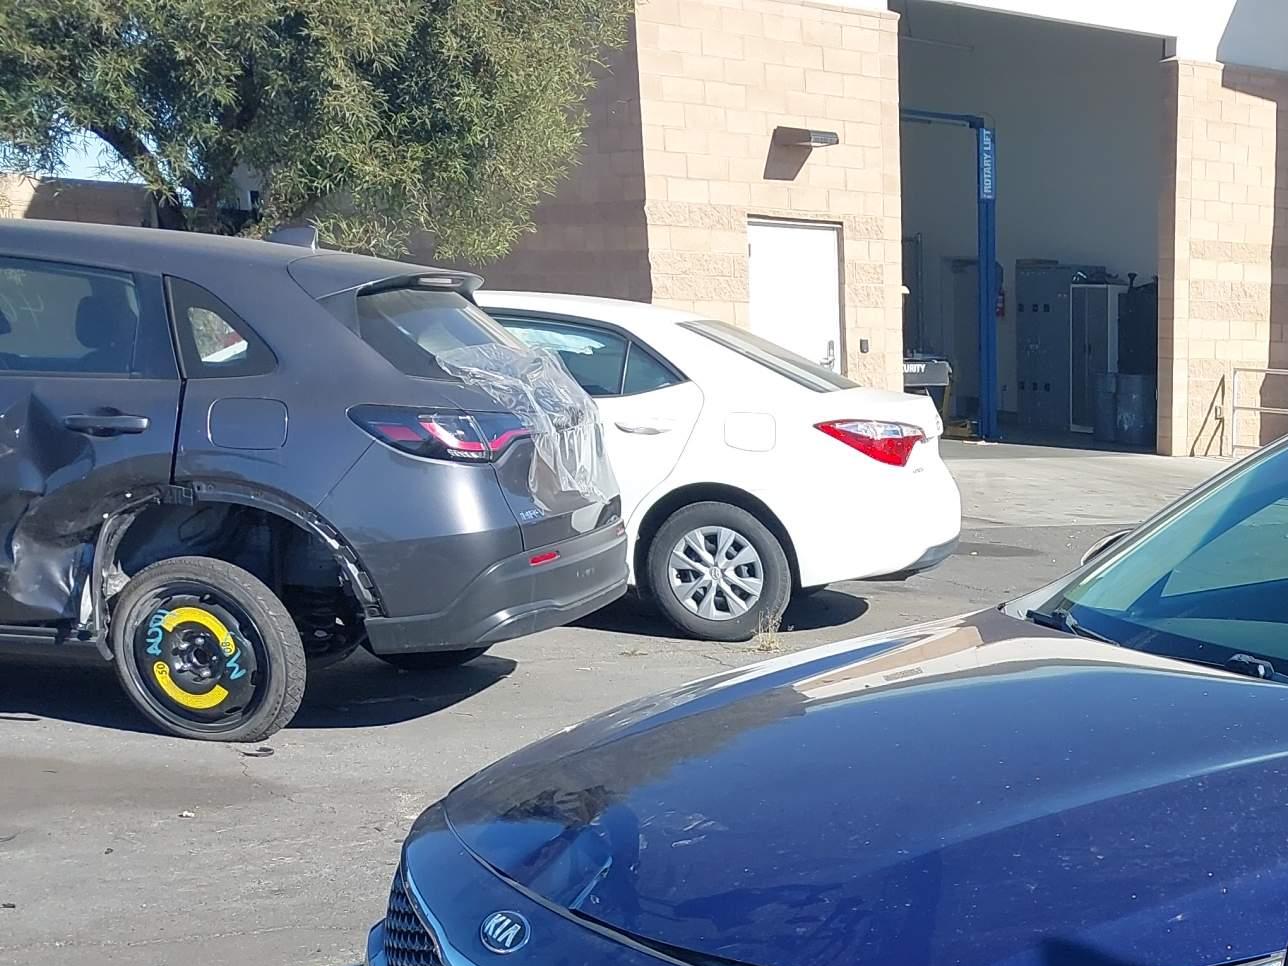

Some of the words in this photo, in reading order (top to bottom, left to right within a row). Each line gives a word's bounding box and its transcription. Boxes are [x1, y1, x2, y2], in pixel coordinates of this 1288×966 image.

[983, 127, 992, 151] LIFT
[983, 152, 992, 193] ROTARY
[902, 363, 926, 373] URITY
[155, 663, 168, 676] 50
[484, 913, 521, 948] KIA
